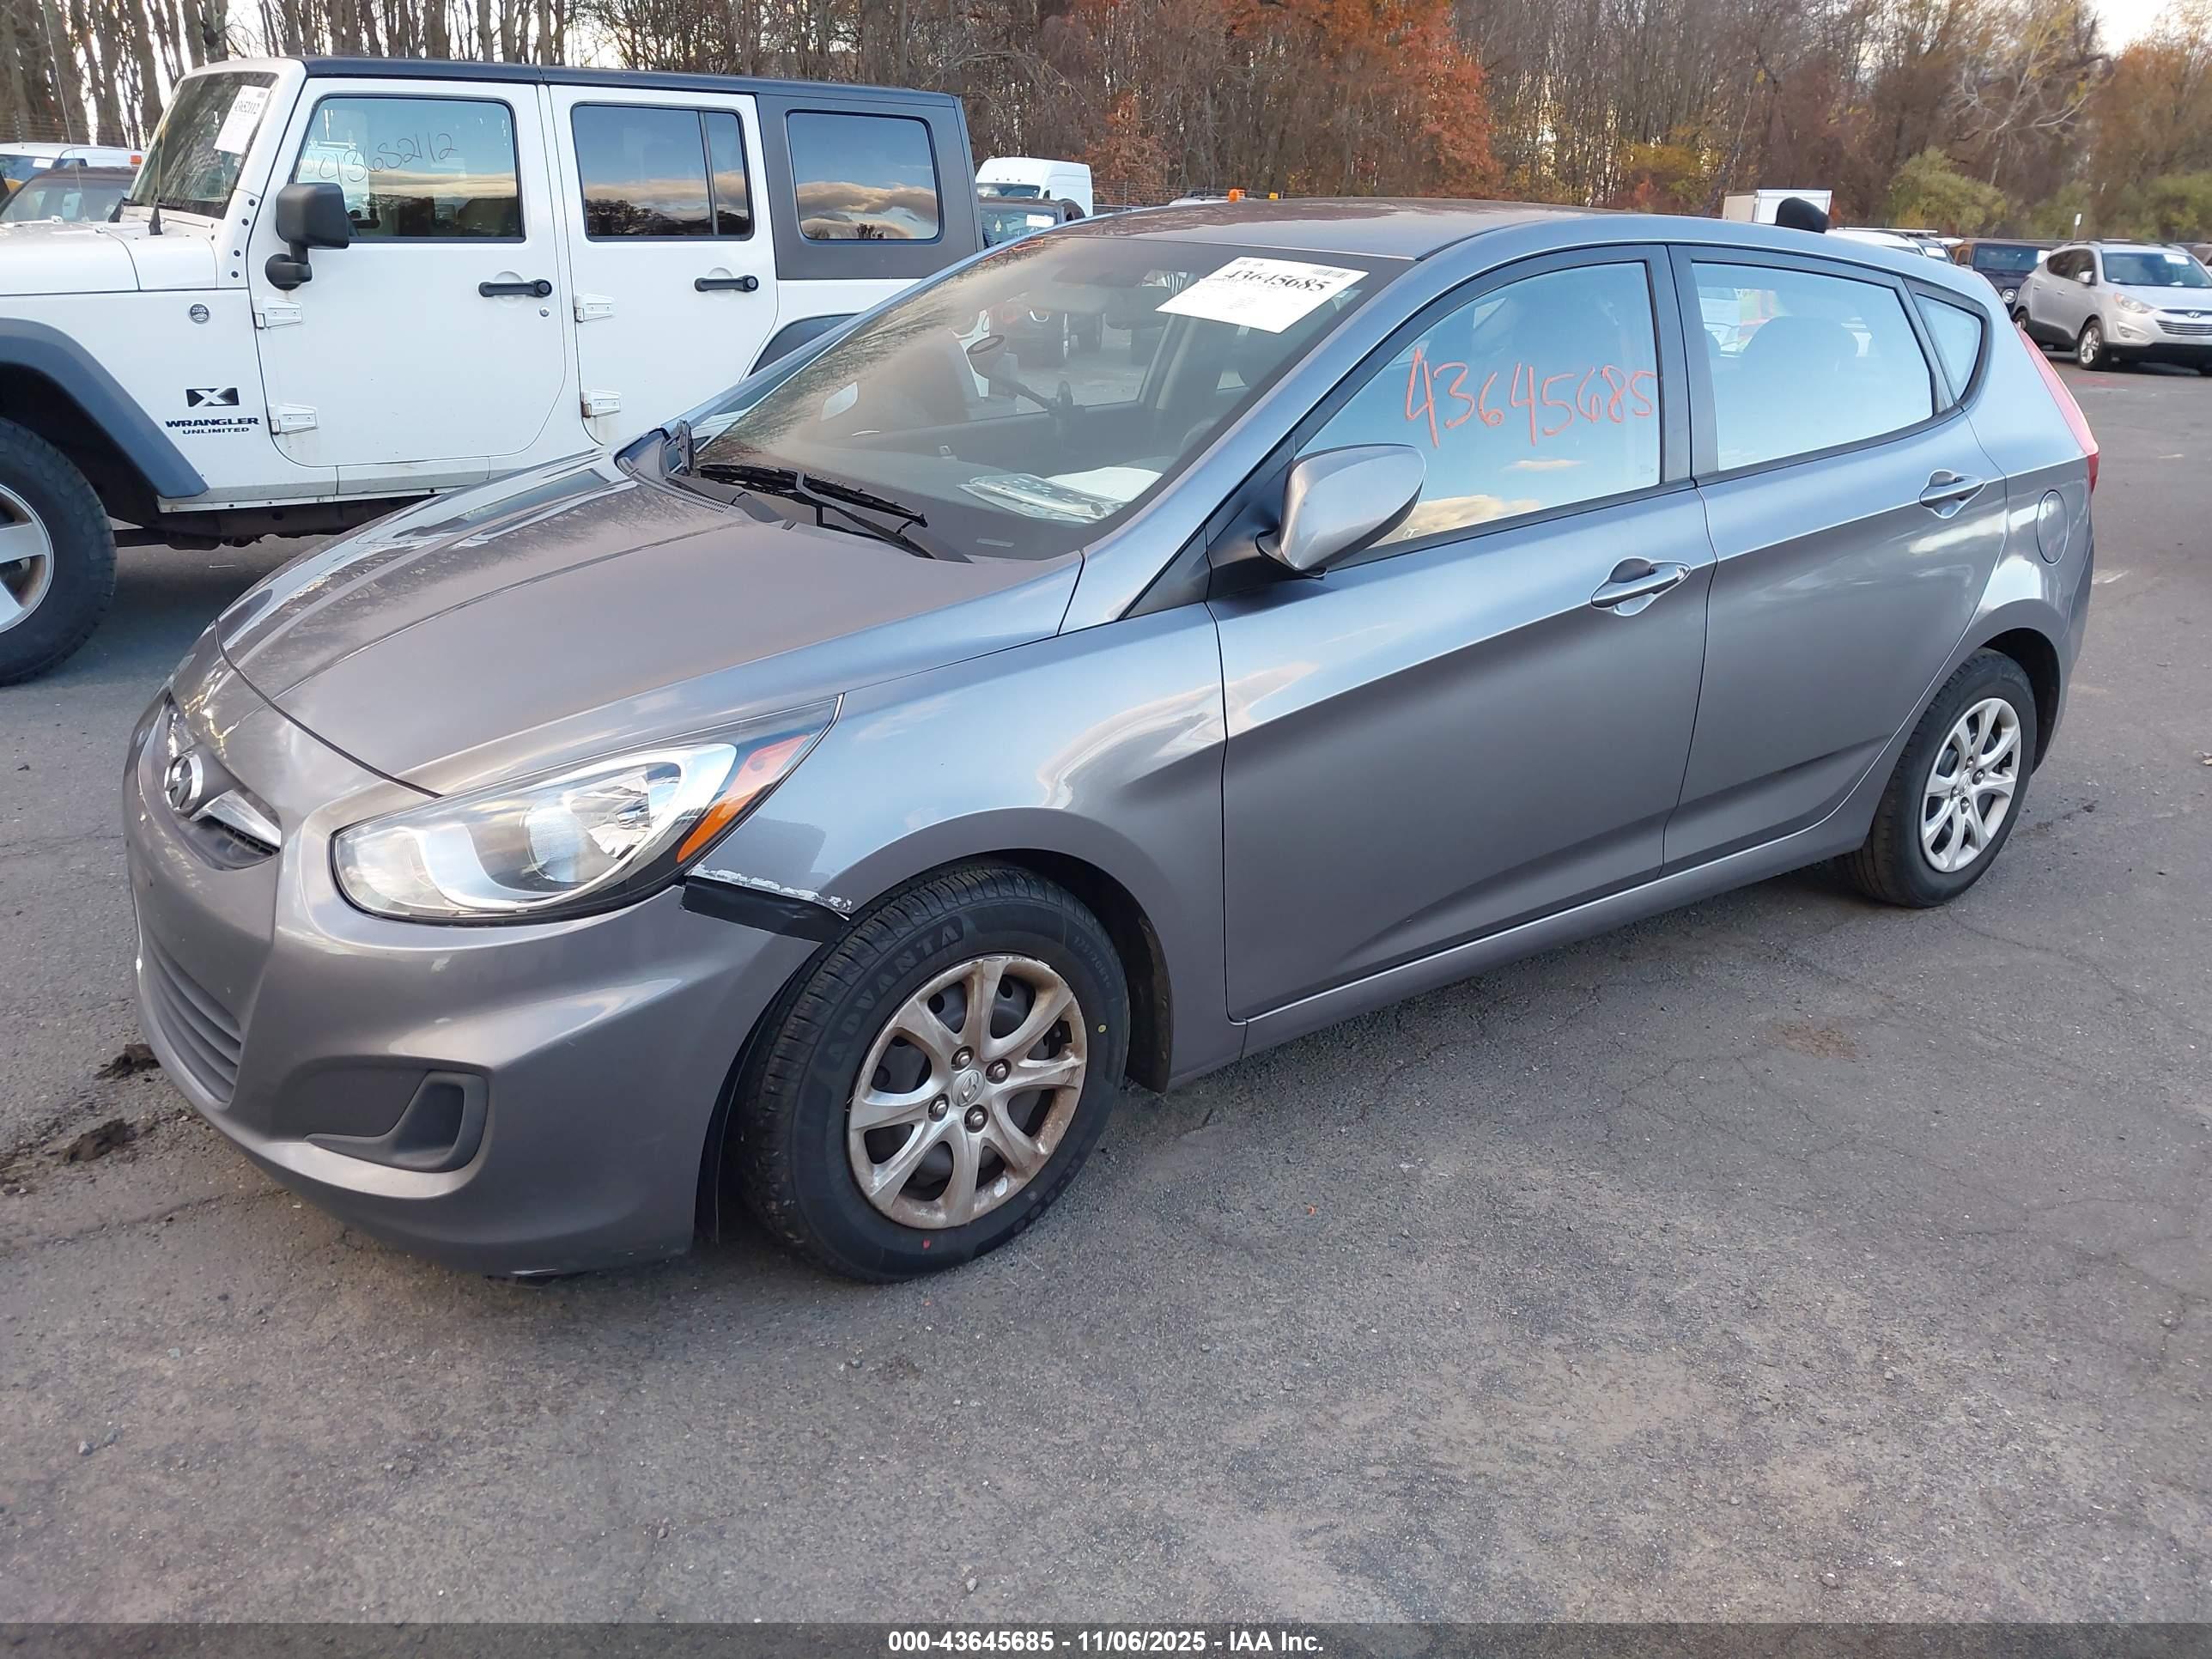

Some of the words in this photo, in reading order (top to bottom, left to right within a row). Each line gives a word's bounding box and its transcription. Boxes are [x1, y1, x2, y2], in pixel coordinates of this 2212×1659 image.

[1224, 270, 1333, 292] 43645685
[165, 417, 259, 428] WRANGLER
[1406, 346, 1656, 448] 43645685
[828, 923, 960, 1065] ADVANTA
